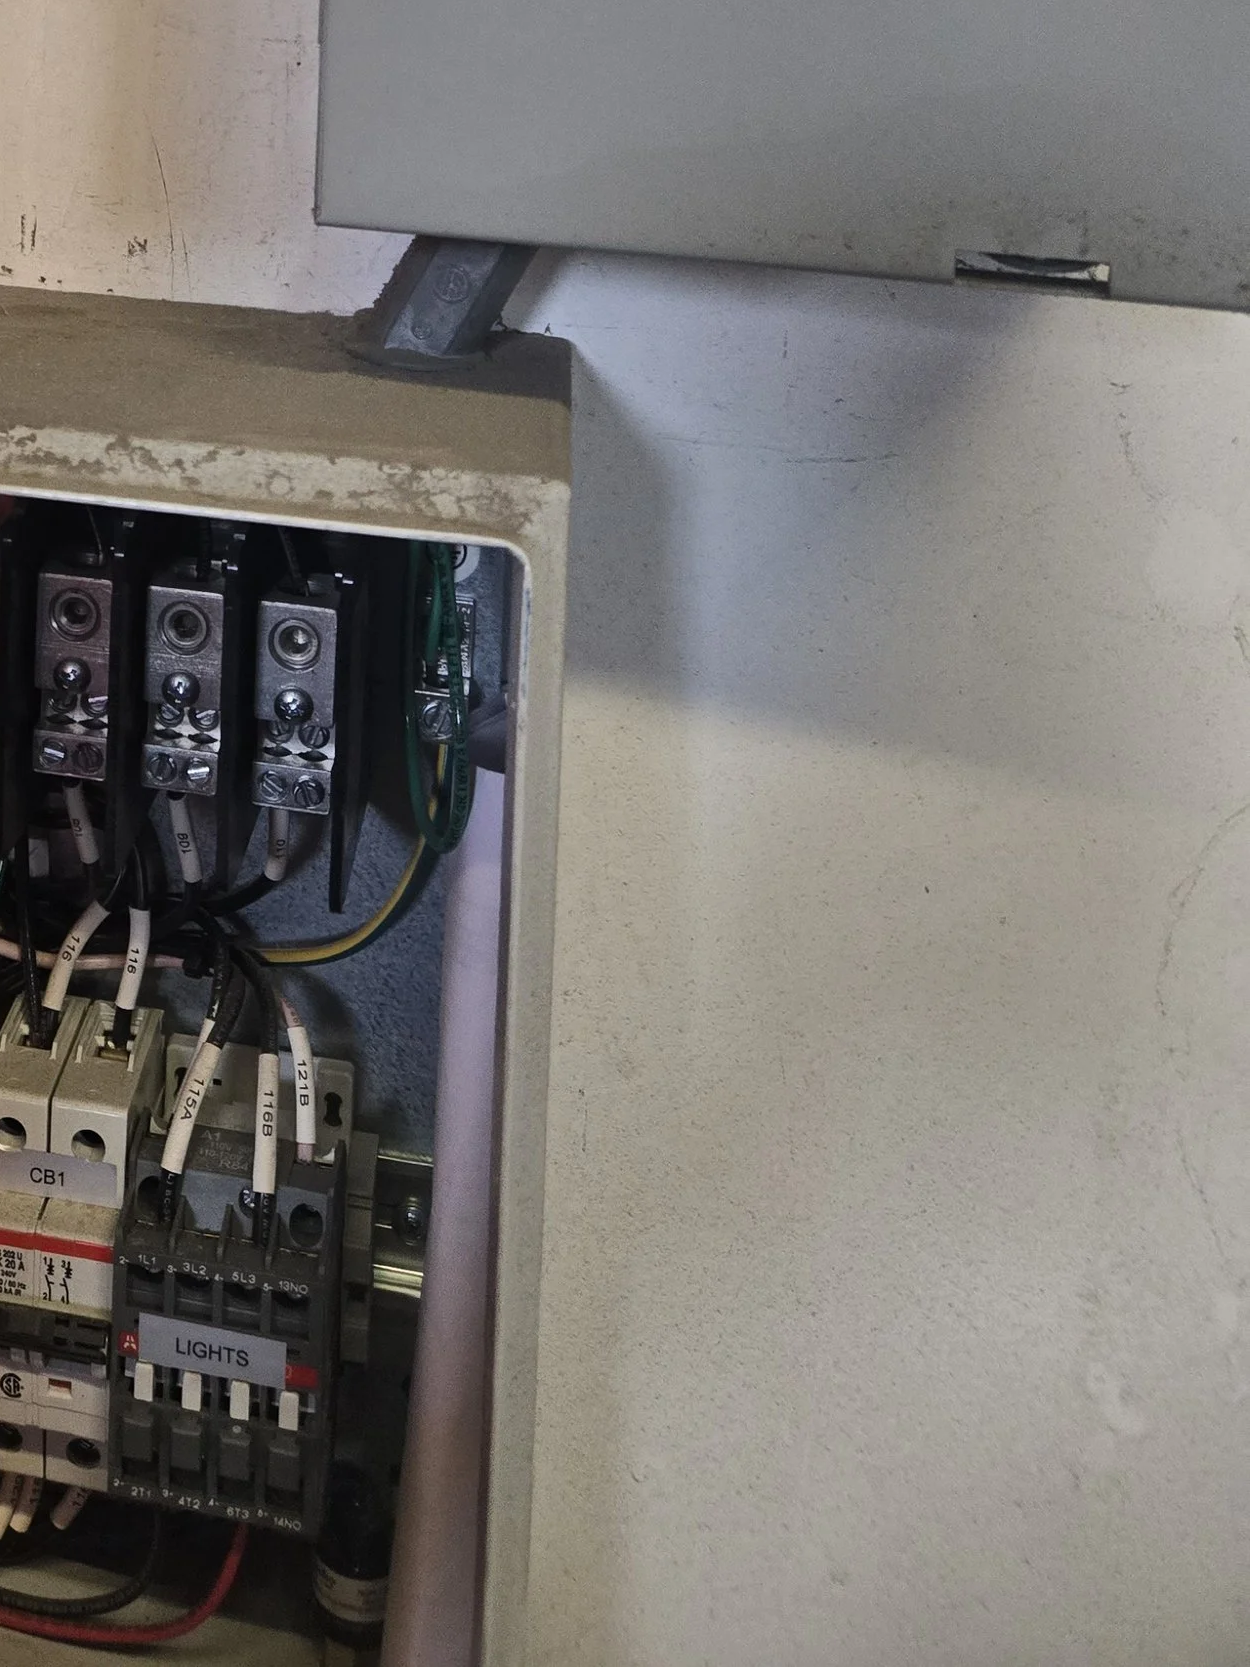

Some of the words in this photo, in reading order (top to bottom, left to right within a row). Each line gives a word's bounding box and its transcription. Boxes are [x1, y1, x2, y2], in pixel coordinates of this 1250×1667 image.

[62, 935, 80, 962] 116
[127, 948, 139, 974] 116
[297, 1060, 309, 1106] 121B
[180, 1078, 205, 1121] 115A
[262, 1090, 274, 1137] 116B
[30, 1167, 65, 1186] CB1
[5, 1259, 16, 1270] 20
[18, 1261, 25, 1271] A
[138, 1254, 157, 1266] 1L1
[182, 1262, 207, 1276] 3L2
[232, 1271, 256, 1284] 5L3
[278, 1280, 309, 1295] 13NO
[175, 1337, 249, 1367] LIGHTS
